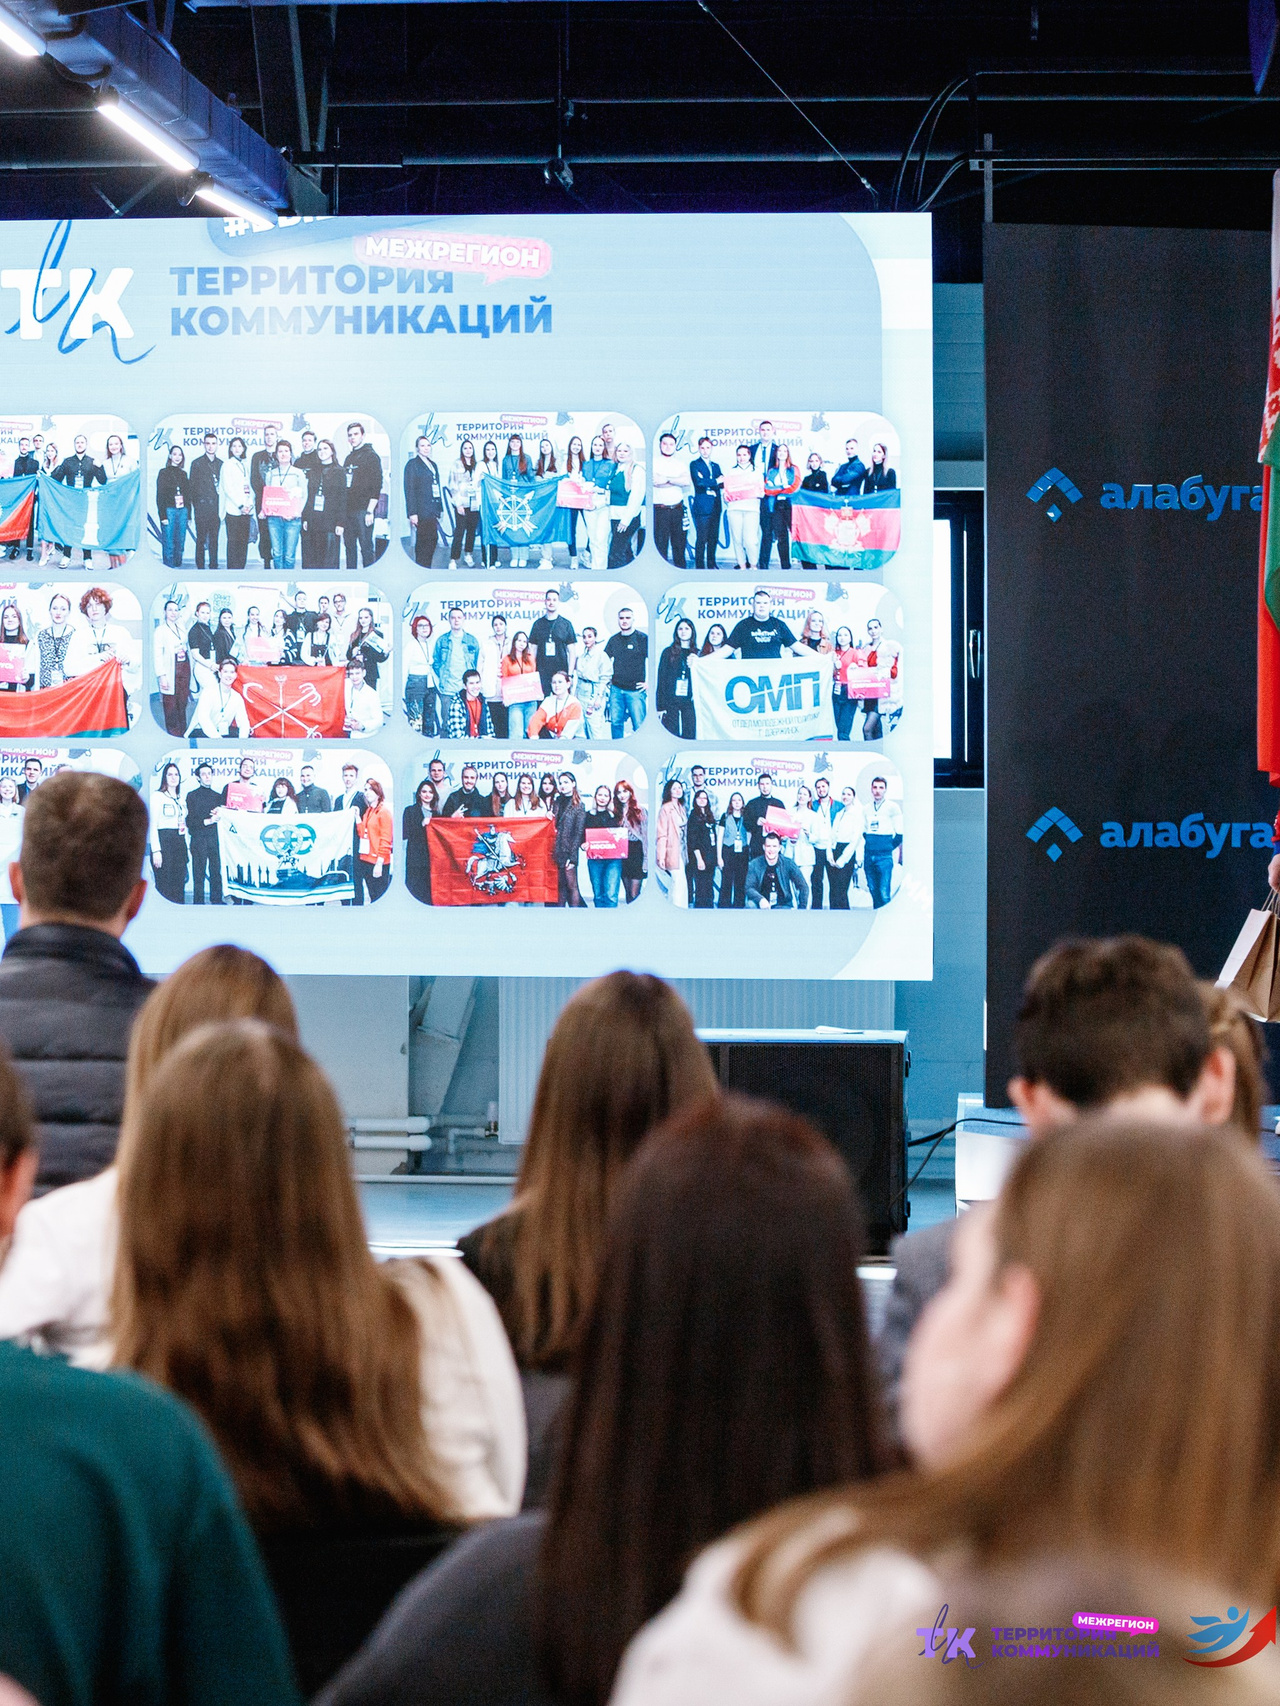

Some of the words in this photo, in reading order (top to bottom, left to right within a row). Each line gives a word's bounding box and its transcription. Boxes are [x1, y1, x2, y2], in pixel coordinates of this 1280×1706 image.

[365, 236, 540, 269] МЕЖРЕГИОН
[169, 264, 454, 297] ТЕРРИТОРИЯ
[171, 296, 553, 338] КОММУНИКАЦИЙ
[183, 427, 258, 436] ТЕРРИТОРИЯ
[456, 422, 524, 431] ТЕРРИТОРИЯ
[1100, 474, 1263, 522] алабуга
[725, 671, 820, 714] ОМП
[1100, 812, 1275, 859] алабуга
